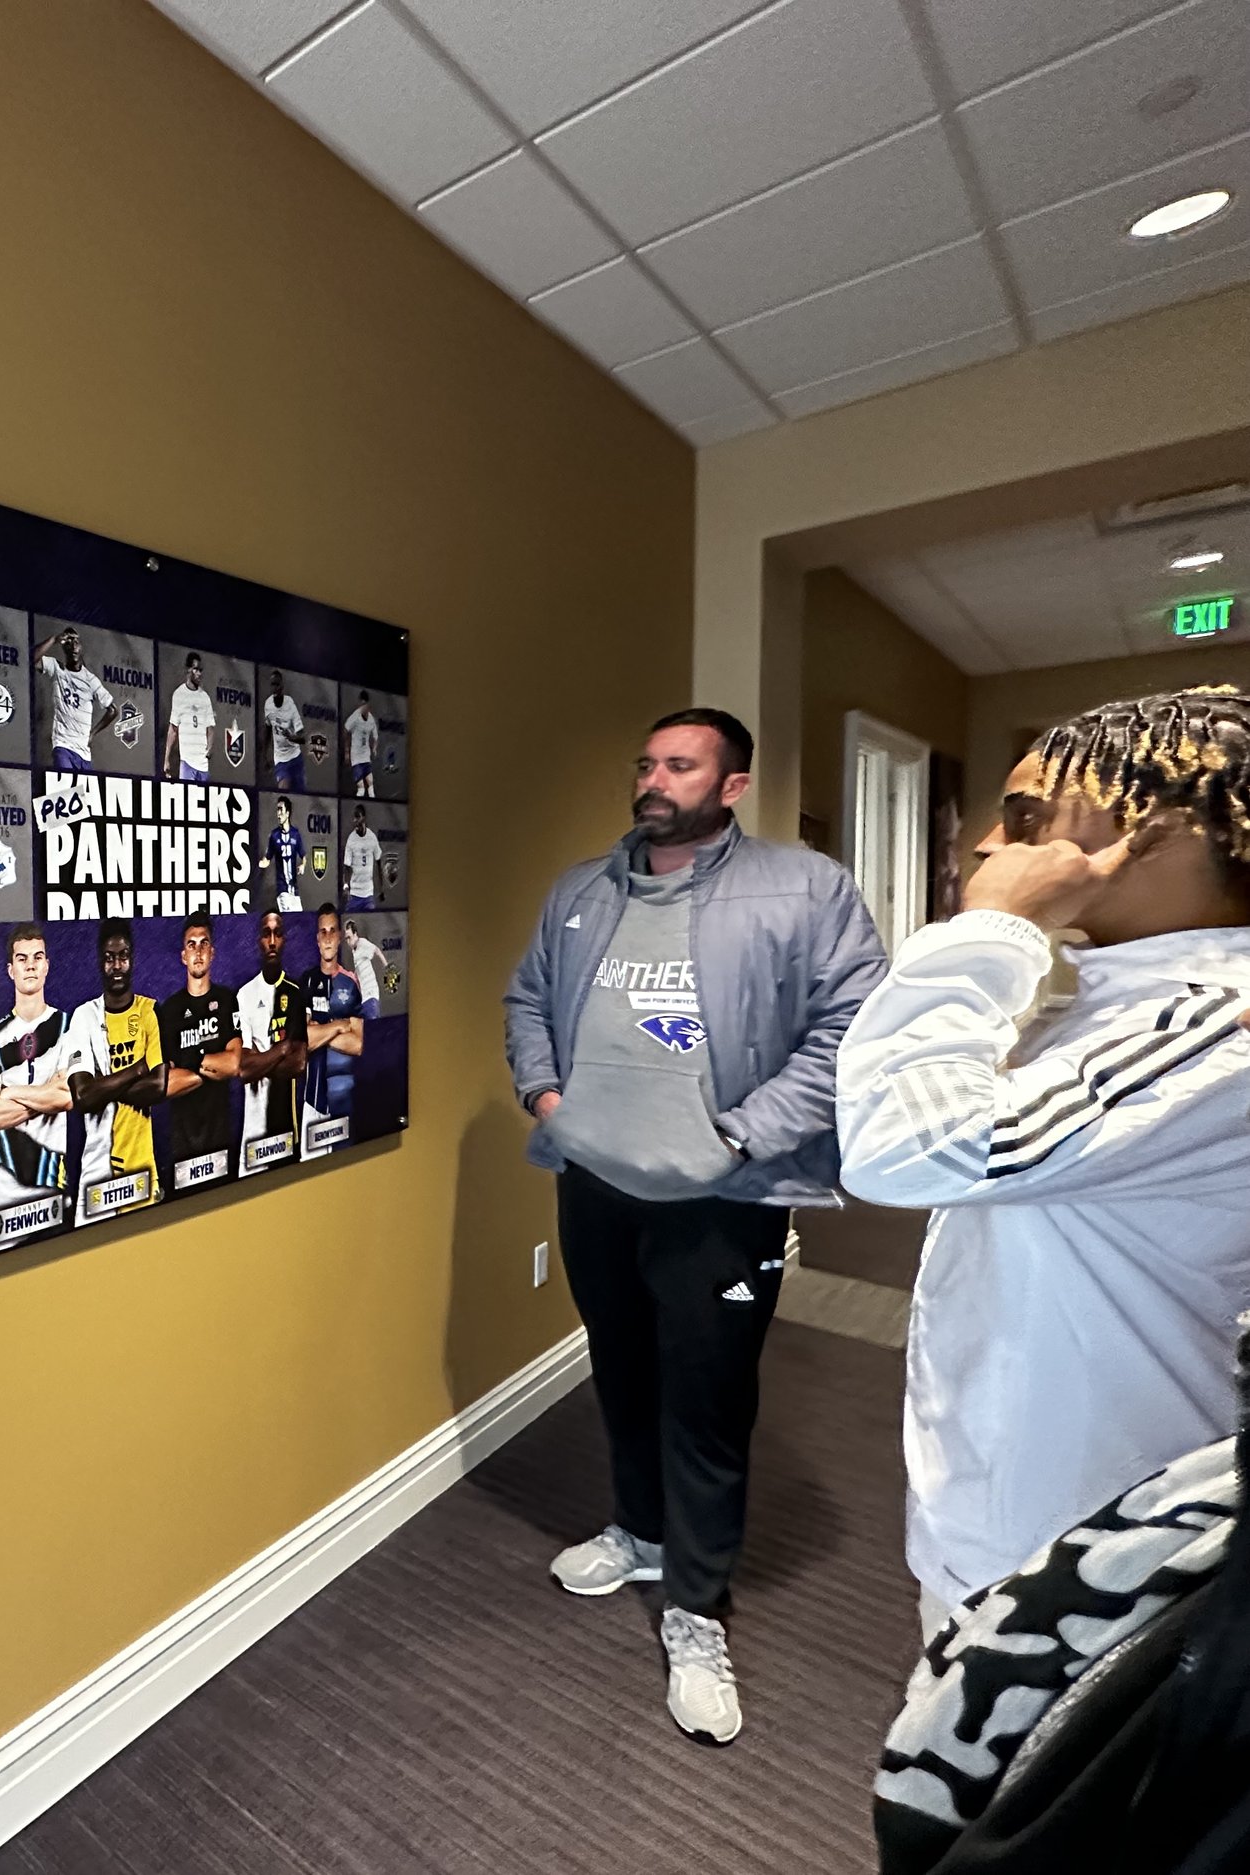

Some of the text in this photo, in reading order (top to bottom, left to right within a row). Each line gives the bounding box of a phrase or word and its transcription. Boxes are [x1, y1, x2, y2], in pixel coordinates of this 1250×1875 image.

[1176, 598, 1234, 635] EXIT
[103, 664, 153, 690] MALCOLM
[41, 792, 84, 823] PRO
[307, 813, 332, 834] CHOI
[47, 822, 251, 884] PANTHERS
[593, 958, 696, 989] ANTHER
[199, 1016, 219, 1036] HC
[255, 1141, 286, 1160] YEARWOOD
[190, 1161, 214, 1180] MEYER
[103, 1184, 134, 1205] TETTEH
[5, 1207, 50, 1234] FENWICK
